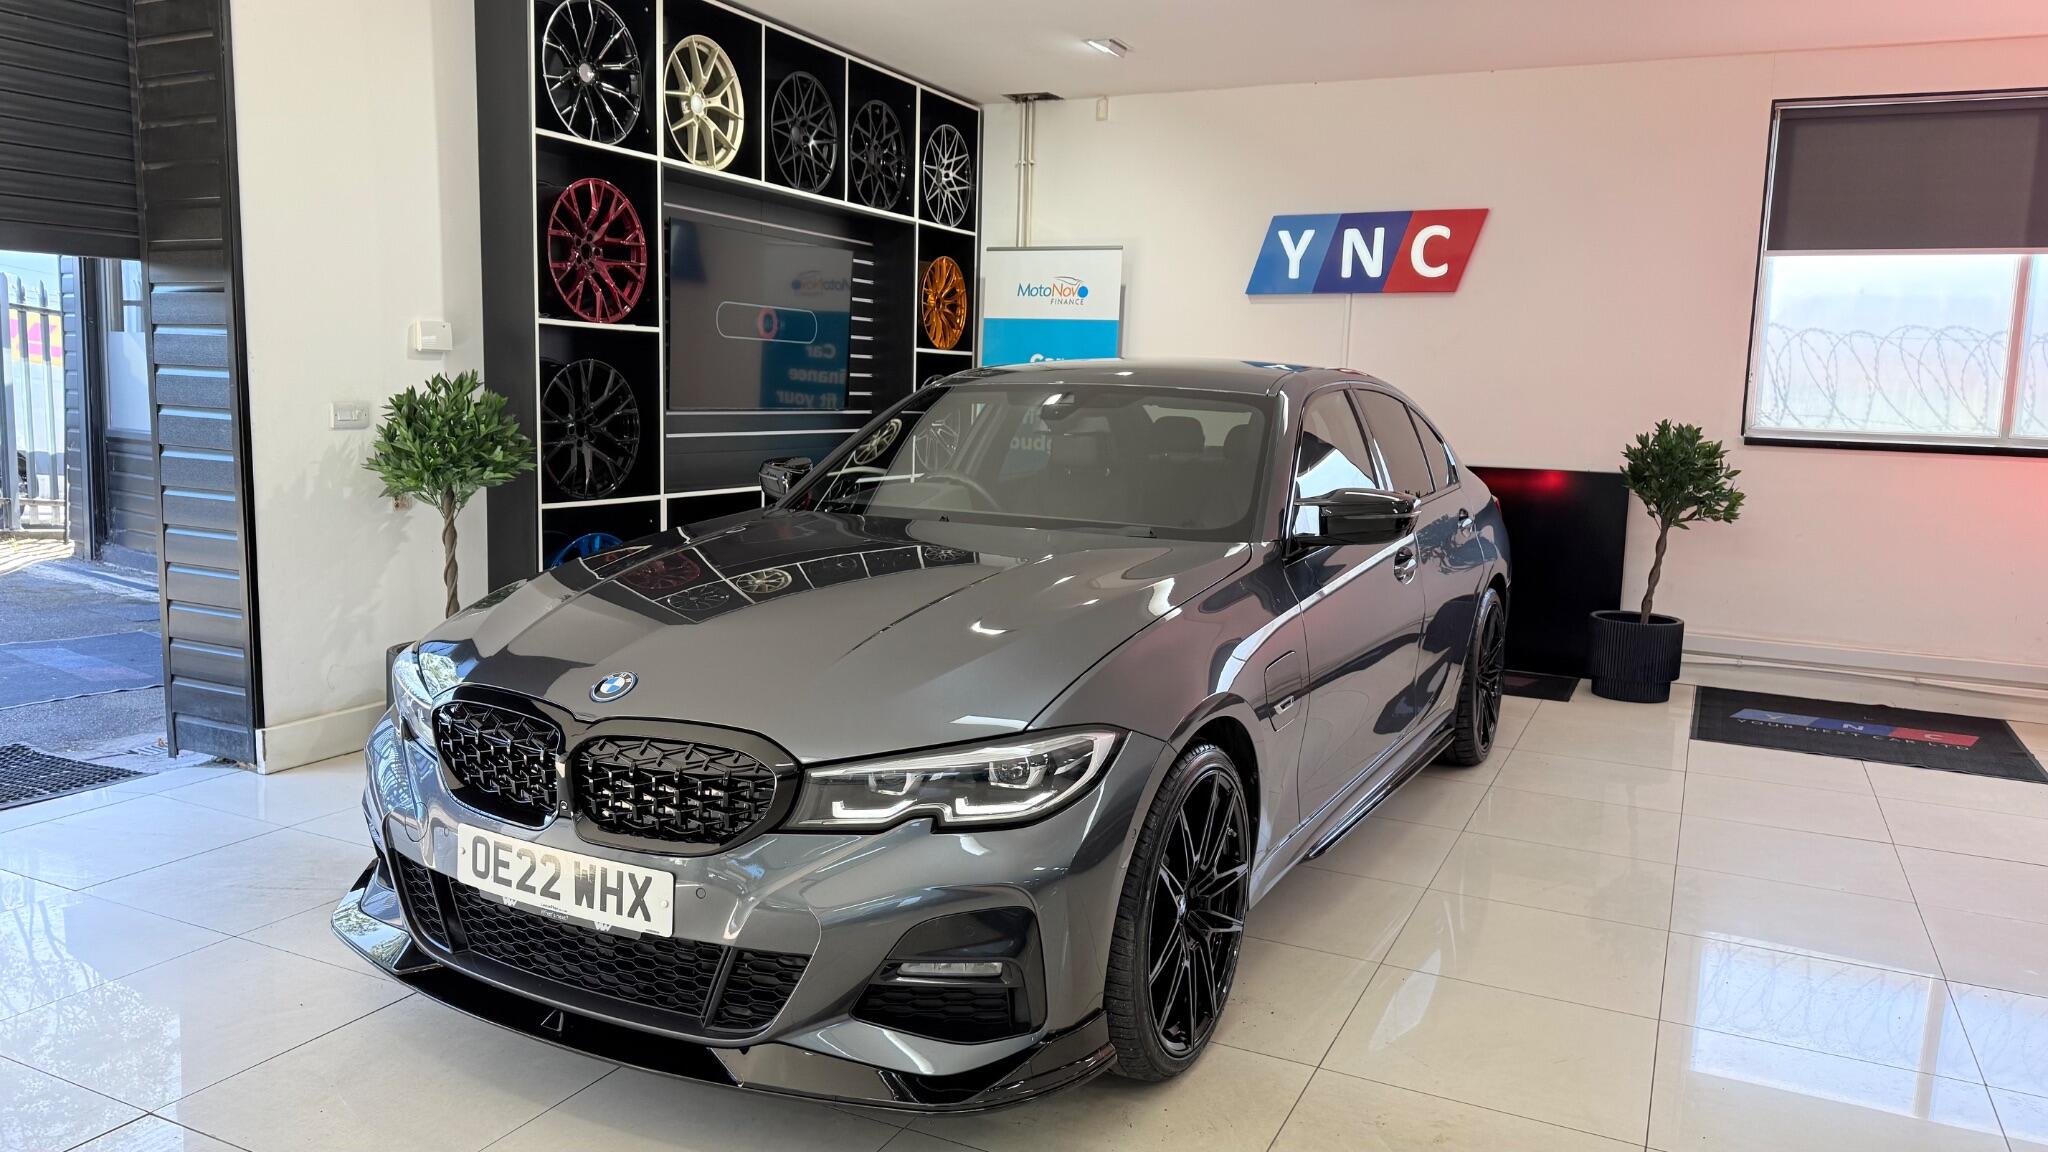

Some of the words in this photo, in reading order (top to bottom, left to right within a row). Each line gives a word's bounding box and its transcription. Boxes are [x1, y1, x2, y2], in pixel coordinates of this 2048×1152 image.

[1277, 224, 1451, 279] YNC
[1017, 283, 1088, 298] MotoNovo
[472, 835, 562, 900] OE22
[574, 861, 653, 922] WHX
